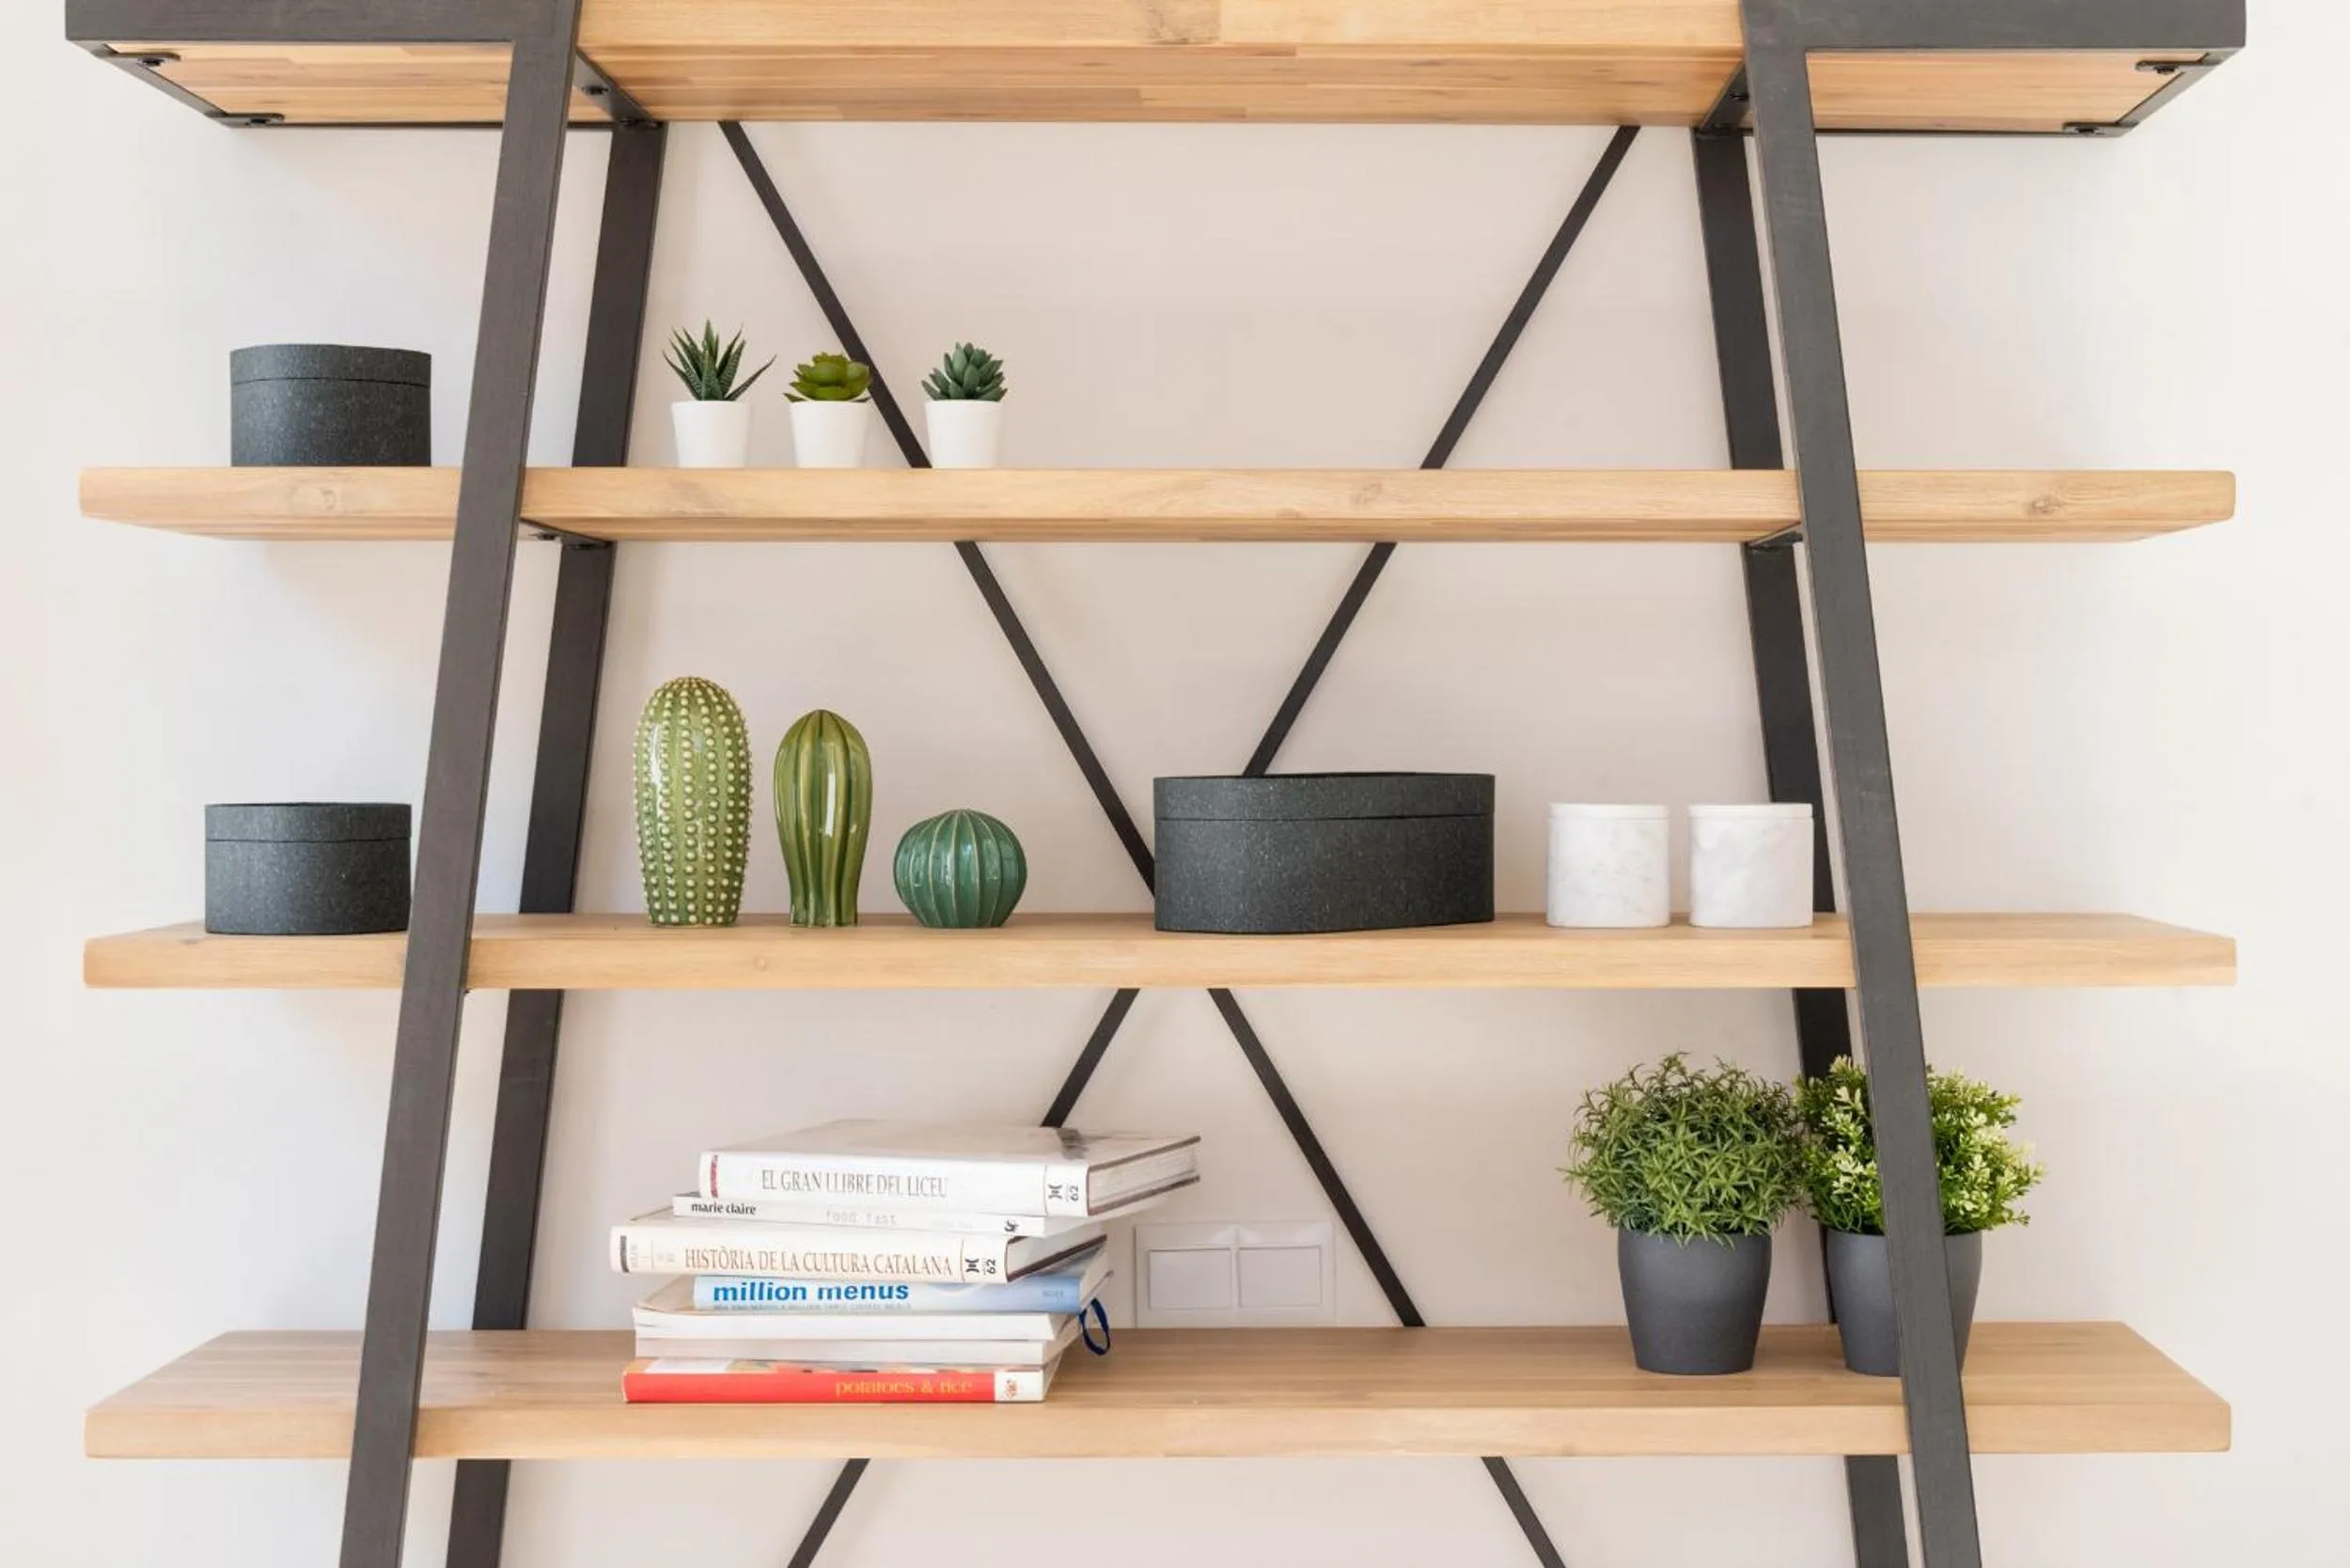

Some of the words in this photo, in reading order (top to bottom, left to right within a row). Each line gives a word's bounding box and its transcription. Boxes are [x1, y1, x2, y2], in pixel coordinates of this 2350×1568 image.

[762, 1168, 777, 1190] EL
[780, 1170, 822, 1191] GRAN
[826, 1172, 874, 1195] LLIBRE
[876, 1174, 904, 1196] DEL
[908, 1176, 948, 1198] LICEU
[1070, 1185, 1079, 1201] 62
[692, 1202, 724, 1214] marie
[726, 1203, 756, 1215] claire
[684, 1246, 754, 1270] HISTÒRIA
[759, 1250, 778, 1270] DE
[781, 1251, 800, 1272] LA
[803, 1252, 871, 1274] CULTURA
[874, 1254, 952, 1276] CATALANA
[987, 1259, 996, 1275] 62
[713, 1281, 807, 1301] million
[818, 1284, 910, 1300] menus
[836, 1379, 916, 1397] potatoes
[921, 1380, 933, 1394] &
[941, 1380, 974, 1394] rice
